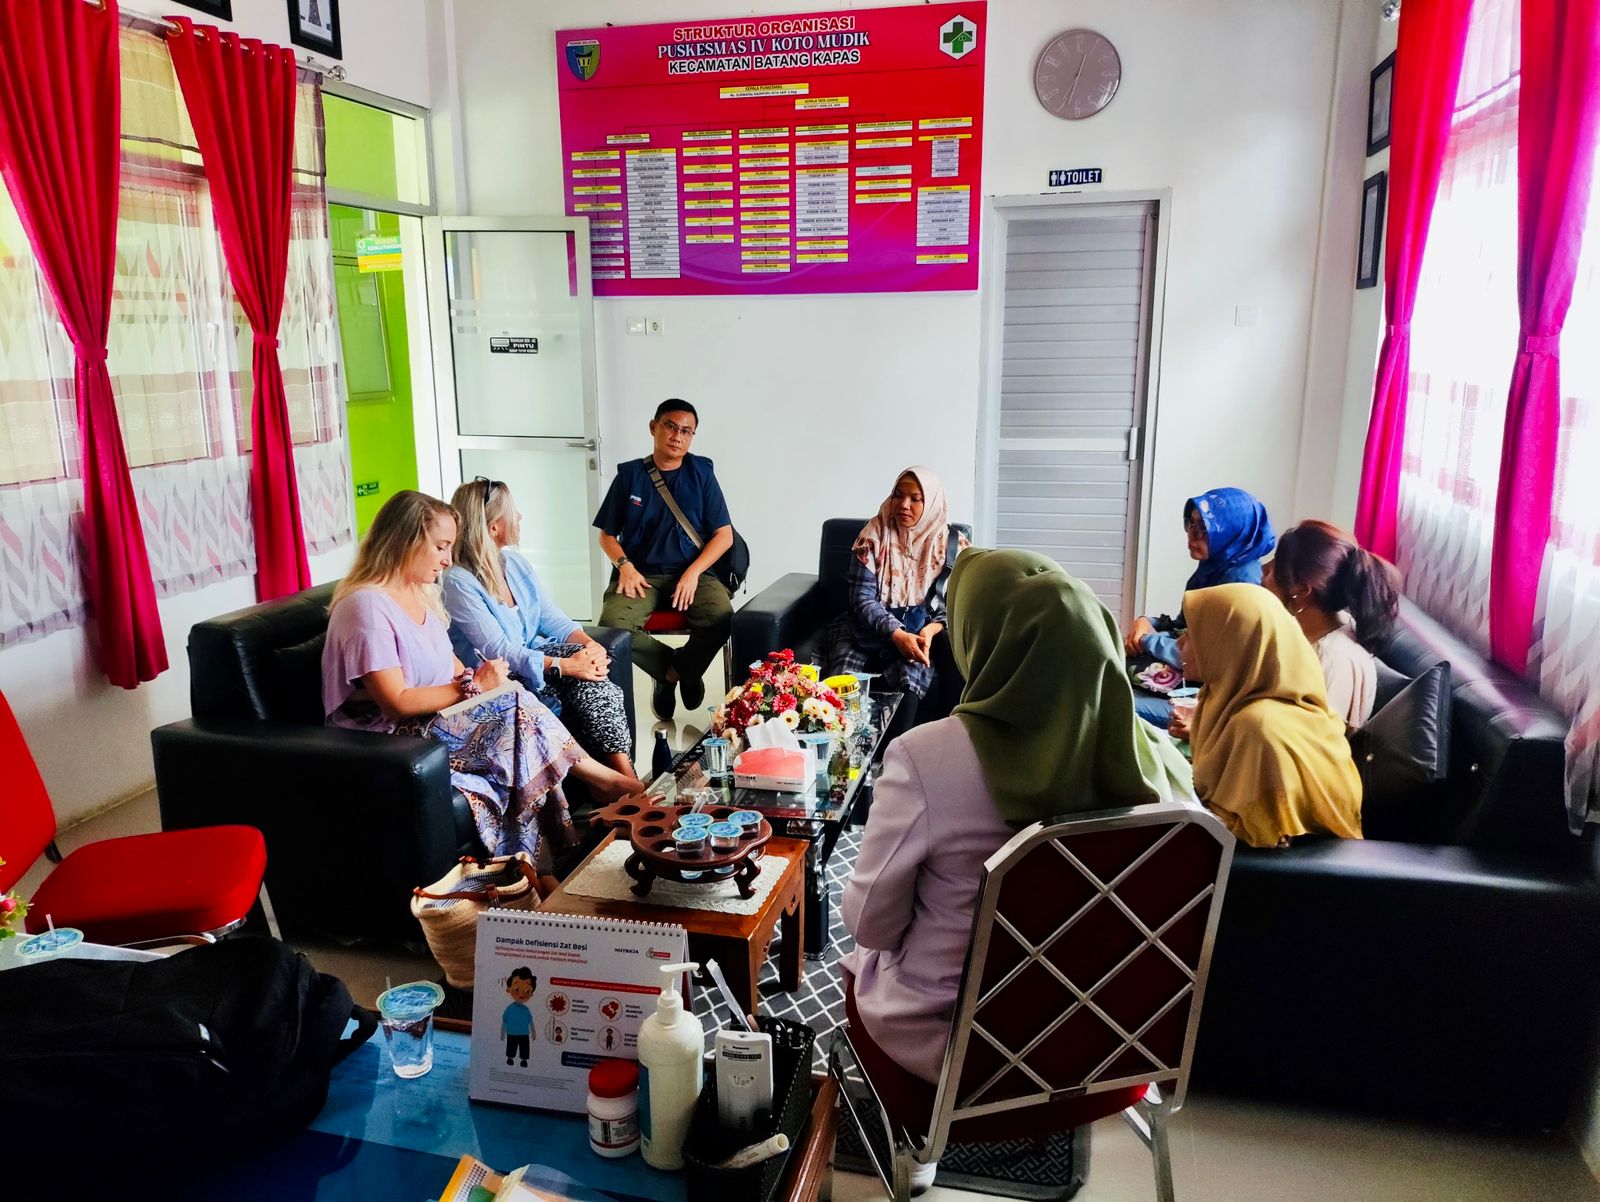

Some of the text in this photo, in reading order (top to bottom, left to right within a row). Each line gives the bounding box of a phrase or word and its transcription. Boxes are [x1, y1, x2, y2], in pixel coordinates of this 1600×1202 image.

[674, 16, 855, 41] STRUKTUR ORGANISASI
[658, 32, 870, 58] PUSKESMAS IV KOTO MUDIK
[669, 49, 860, 75] KECAMATAN BATANG KAPAS
[1066, 170, 1100, 184] TOILET
[496, 936, 587, 951] Dampak Defisiensi Zat Besi
